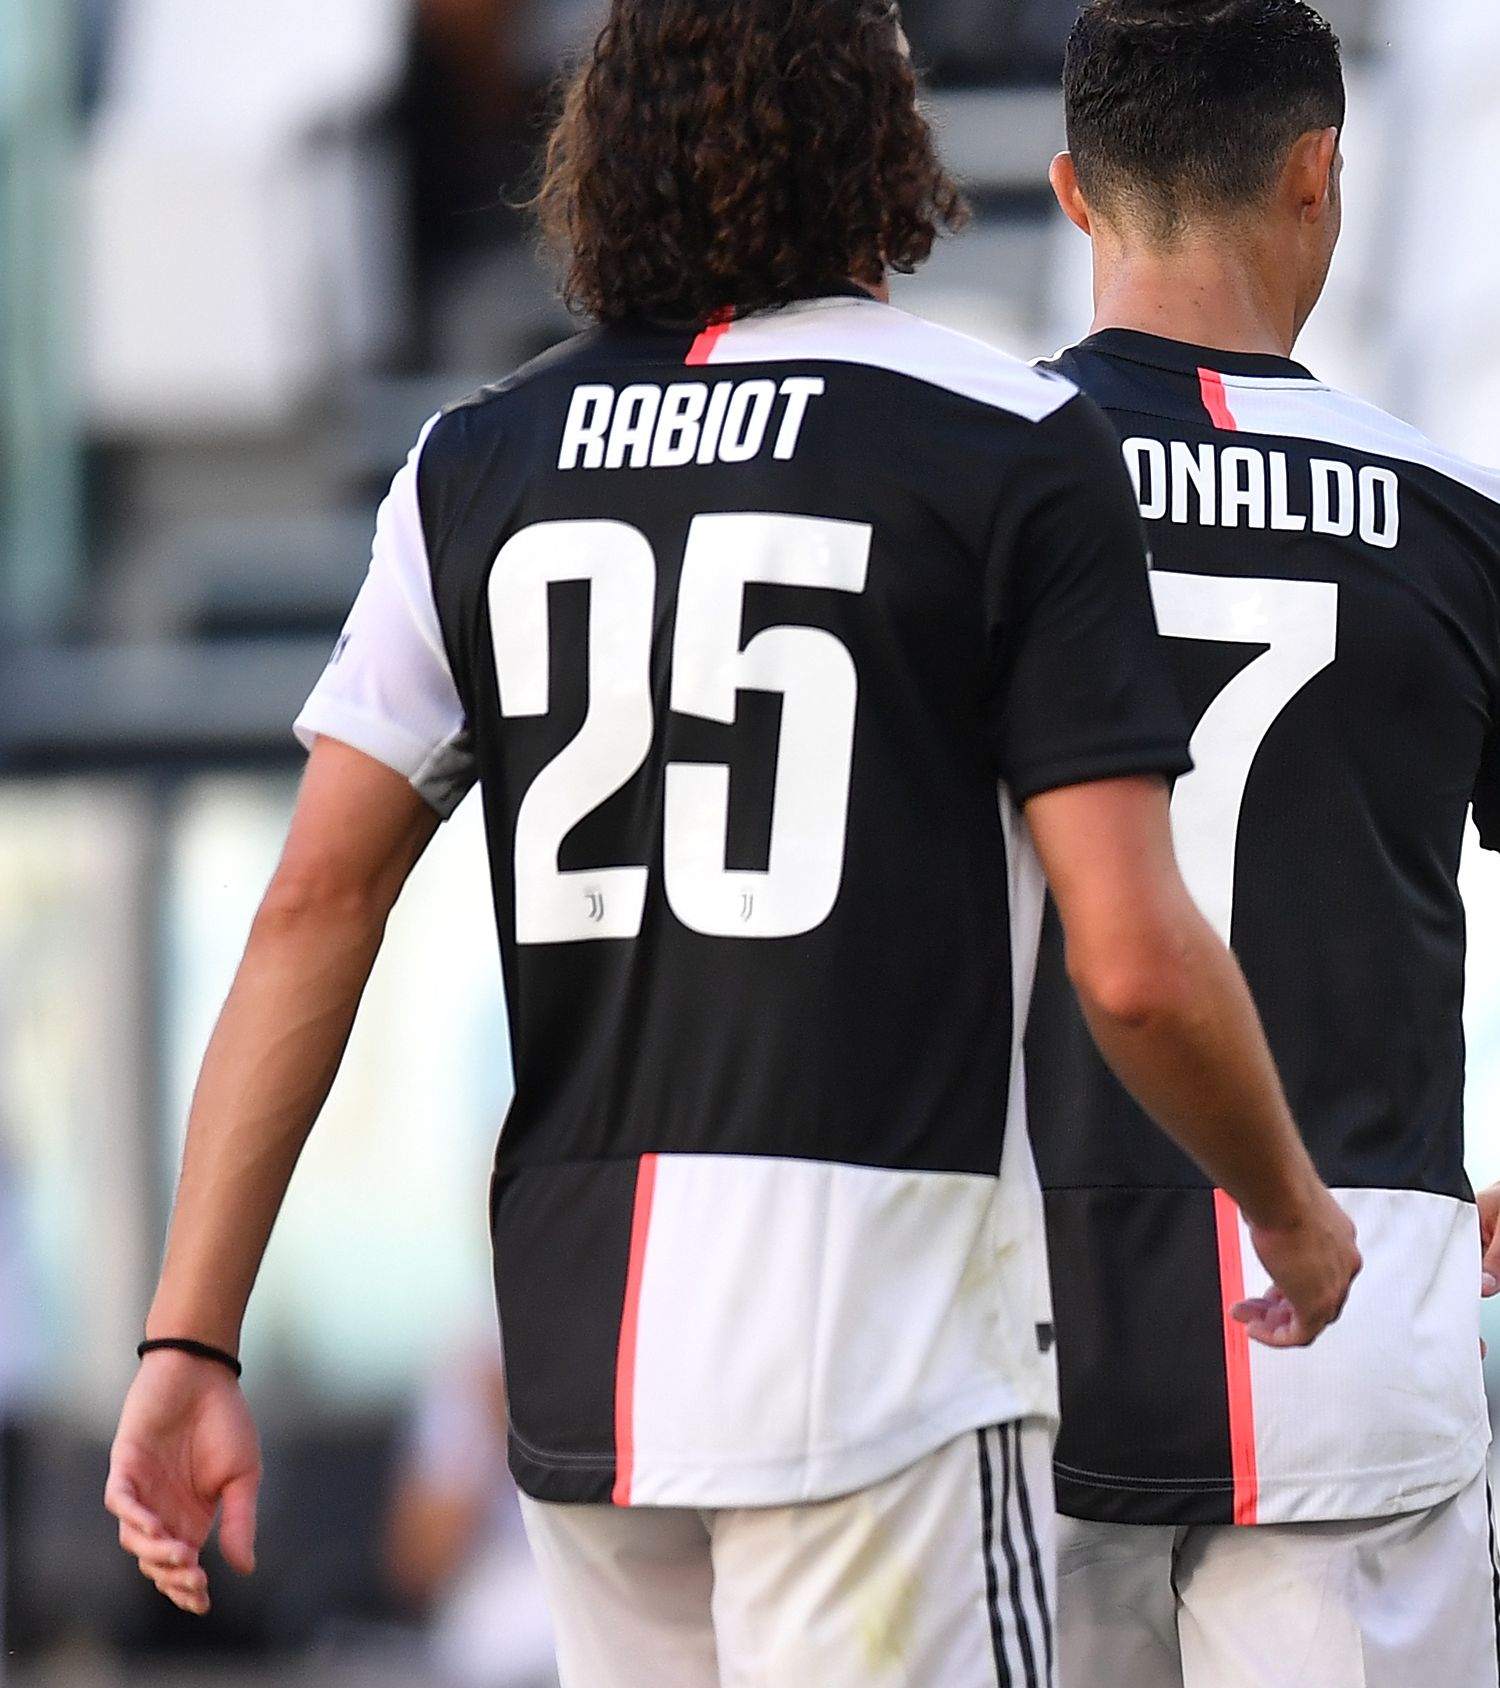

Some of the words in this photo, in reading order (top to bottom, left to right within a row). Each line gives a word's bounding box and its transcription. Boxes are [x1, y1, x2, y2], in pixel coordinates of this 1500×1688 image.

[557, 376, 825, 471] RABIOT
[1122, 437, 1400, 549] ONALDO
[487, 511, 873, 945] 25
[1148, 569, 1339, 952] 7
